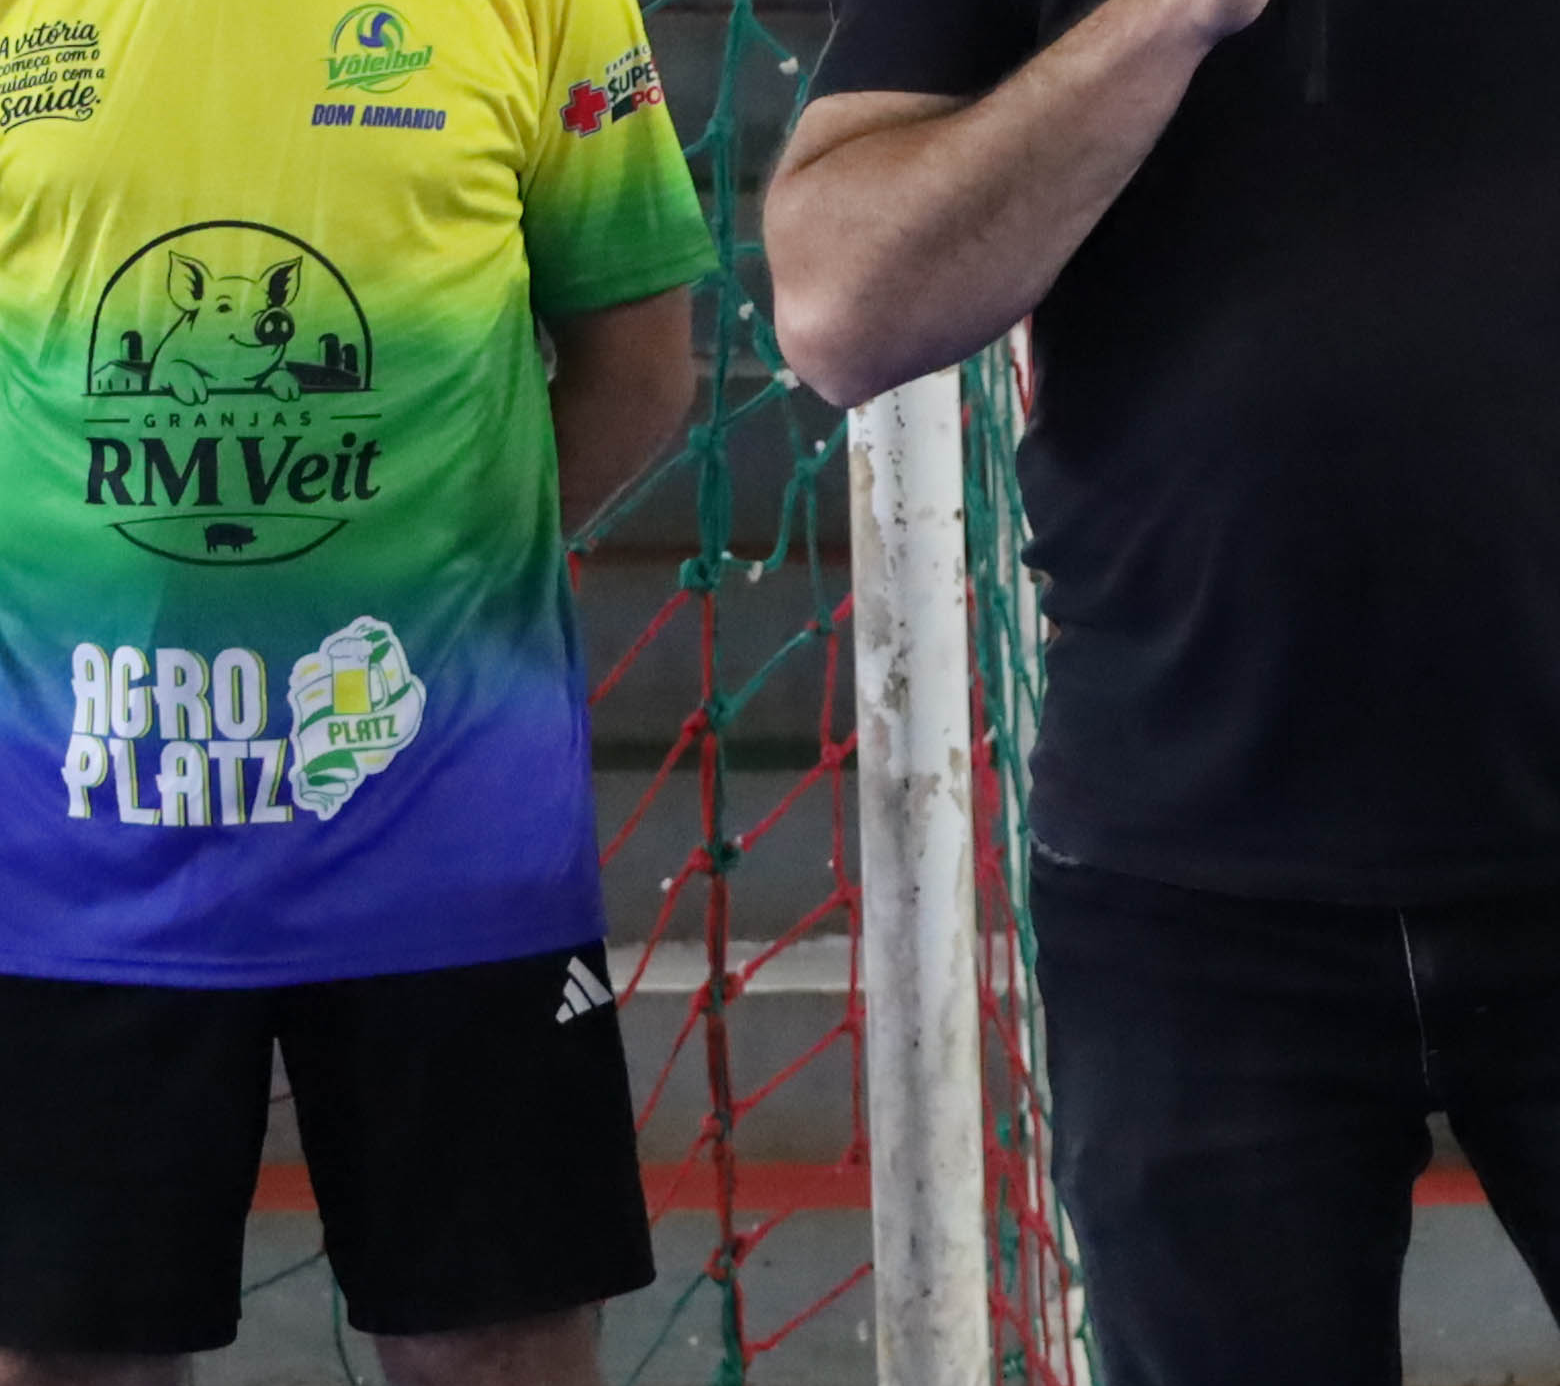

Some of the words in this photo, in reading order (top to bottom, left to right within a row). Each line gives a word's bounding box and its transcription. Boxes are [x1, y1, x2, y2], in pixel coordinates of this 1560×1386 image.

[15, 20, 101, 54] vitória
[55, 49, 88, 63] com
[91, 48, 101, 61] o
[62, 67, 93, 82] com
[607, 60, 659, 104] SUPE
[311, 103, 356, 127] DOM
[360, 104, 447, 132] ARMANDO
[143, 410, 312, 429] GRANJAS
[84, 436, 223, 507] RM
[236, 431, 383, 506] Veit
[71, 641, 269, 741] AGRO
[326, 714, 400, 746] PLATZ
[60, 732, 294, 828] PLATZ
